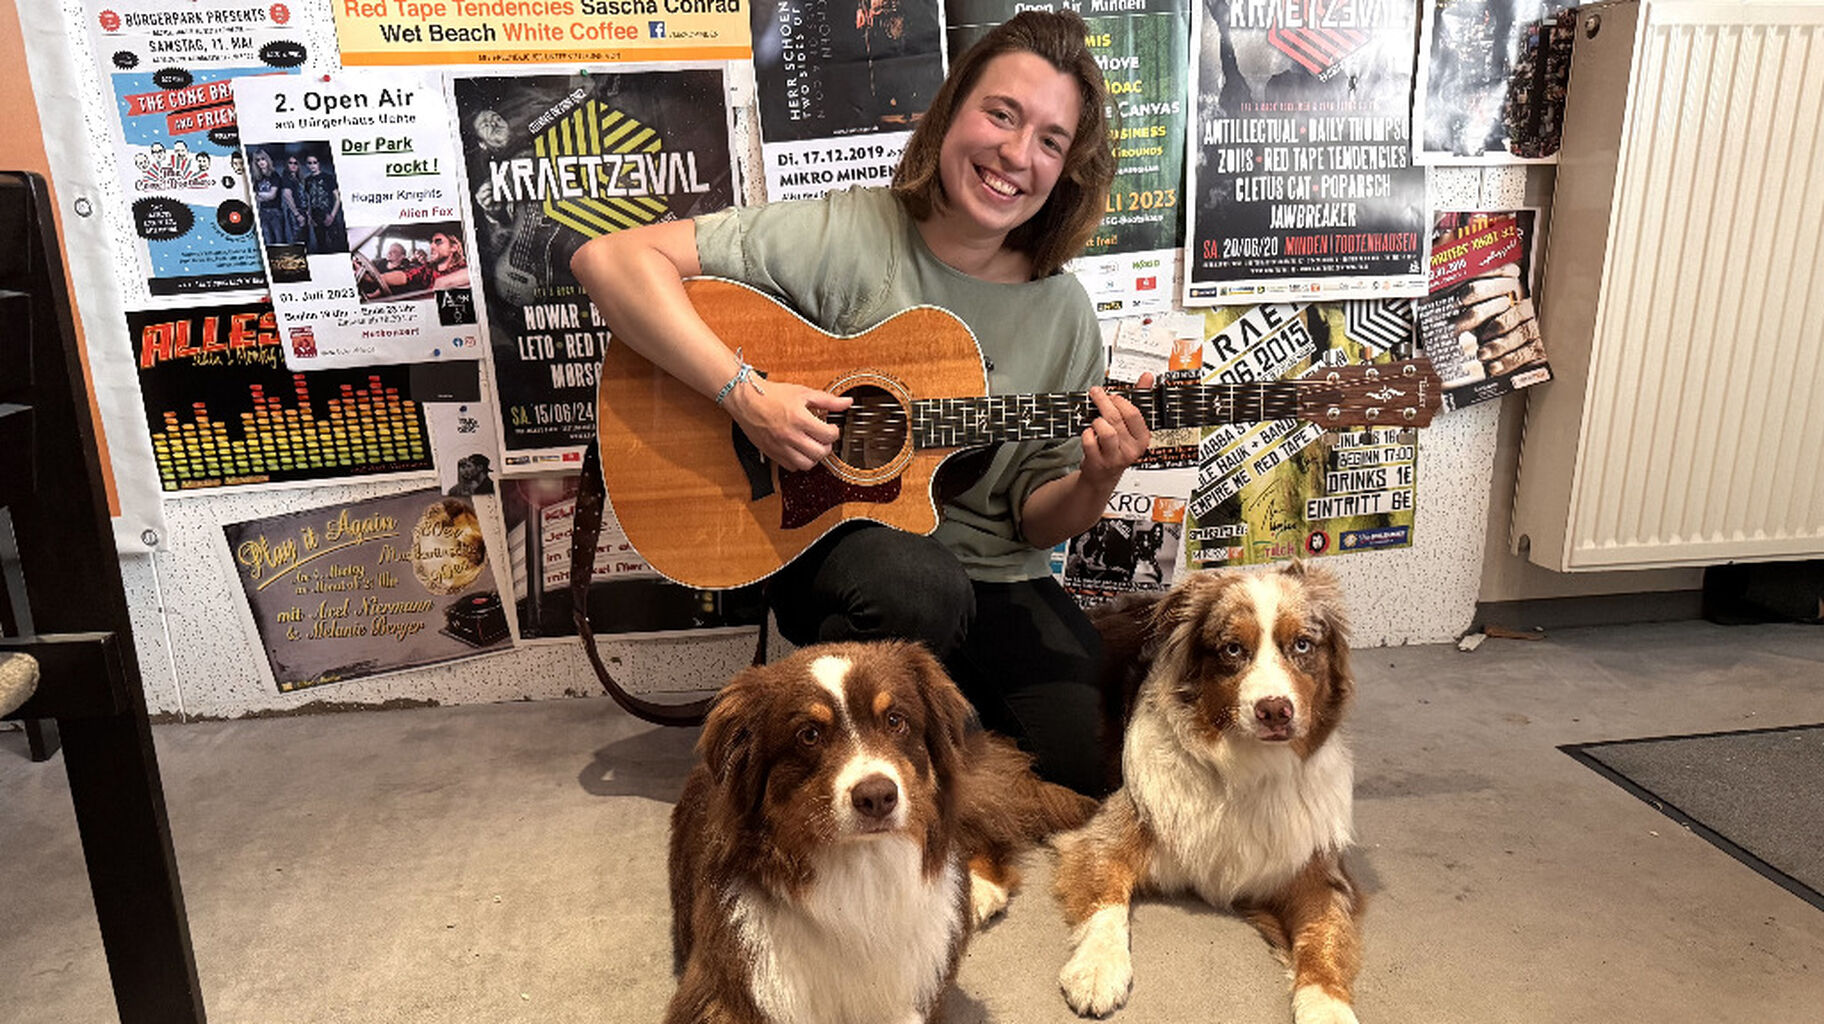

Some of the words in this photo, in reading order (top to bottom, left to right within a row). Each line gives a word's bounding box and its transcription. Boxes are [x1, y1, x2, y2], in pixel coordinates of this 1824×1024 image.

[125, 11, 203, 27] BÜRGERPARK
[206, 8, 267, 23] PRESENTS
[345, 0, 387, 17] Red
[397, 0, 452, 19] Tape
[456, 0, 575, 16] Tendencies
[582, 0, 657, 15] Sascha
[666, 0, 741, 14] Conrad
[1015, 2, 1053, 14] Open
[1062, 0, 1082, 13] Air
[1091, 0, 1146, 12] Minden
[231, 37, 254, 50] MAI
[379, 24, 422, 43] Wet
[429, 23, 496, 43] Beach
[502, 22, 564, 42] White
[570, 21, 639, 40] Coffee
[137, 94, 166, 113] THE
[169, 88, 206, 108] CONE
[275, 93, 295, 113] 2.
[304, 91, 368, 114] Open
[379, 89, 414, 107] Air
[786, 78, 801, 120] HERR
[800, 85, 812, 118] TWO
[275, 121, 295, 129] am
[299, 116, 375, 130] Bürgerhaus
[1204, 118, 1299, 145] ANTILLECTUAL
[1309, 117, 1344, 142] DAILY
[341, 139, 370, 153] Der
[375, 137, 413, 151] Park
[778, 152, 798, 166] Di.
[803, 145, 884, 164] 17.12.2019
[386, 160, 428, 174] rockt
[433, 158, 438, 172] !
[1264, 147, 1289, 171] RED
[1292, 147, 1324, 171] TAPE
[1327, 145, 1407, 169] TENDENCIES
[779, 170, 833, 187] MIKRO
[1235, 176, 1284, 201] CLETUS
[1287, 175, 1311, 200] CAT
[1321, 174, 1391, 199] POPARSCH
[397, 189, 443, 202] Knights
[1129, 188, 1177, 211] 2023
[399, 208, 429, 219] Alien
[432, 206, 454, 217] Fox
[1270, 203, 1357, 230] JAWBREAKER
[1223, 237, 1279, 258] 20/06/20
[1284, 235, 1328, 257] MINDEN
[302, 290, 324, 301] Juli
[523, 303, 580, 331] NOWAR
[140, 311, 280, 370] ALLES
[518, 333, 555, 361] LETO
[565, 332, 594, 359] RED
[534, 402, 594, 425] 15/06/24
[1200, 428, 1235, 460] JABBA
[1220, 445, 1251, 474] HAUK
[1190, 482, 1233, 518] EMPIRE
[1232, 469, 1251, 488] ME
[1253, 450, 1280, 476] RED
[1279, 430, 1311, 457] TAPE
[1328, 470, 1387, 493] DRINKS
[1307, 493, 1381, 519] EINTRITT
[301, 526, 321, 552] it
[325, 510, 397, 545] Again
[277, 606, 305, 623] mit
[353, 595, 434, 617] Niermann
[306, 620, 367, 641] Melanie
[370, 615, 425, 642] Berger
